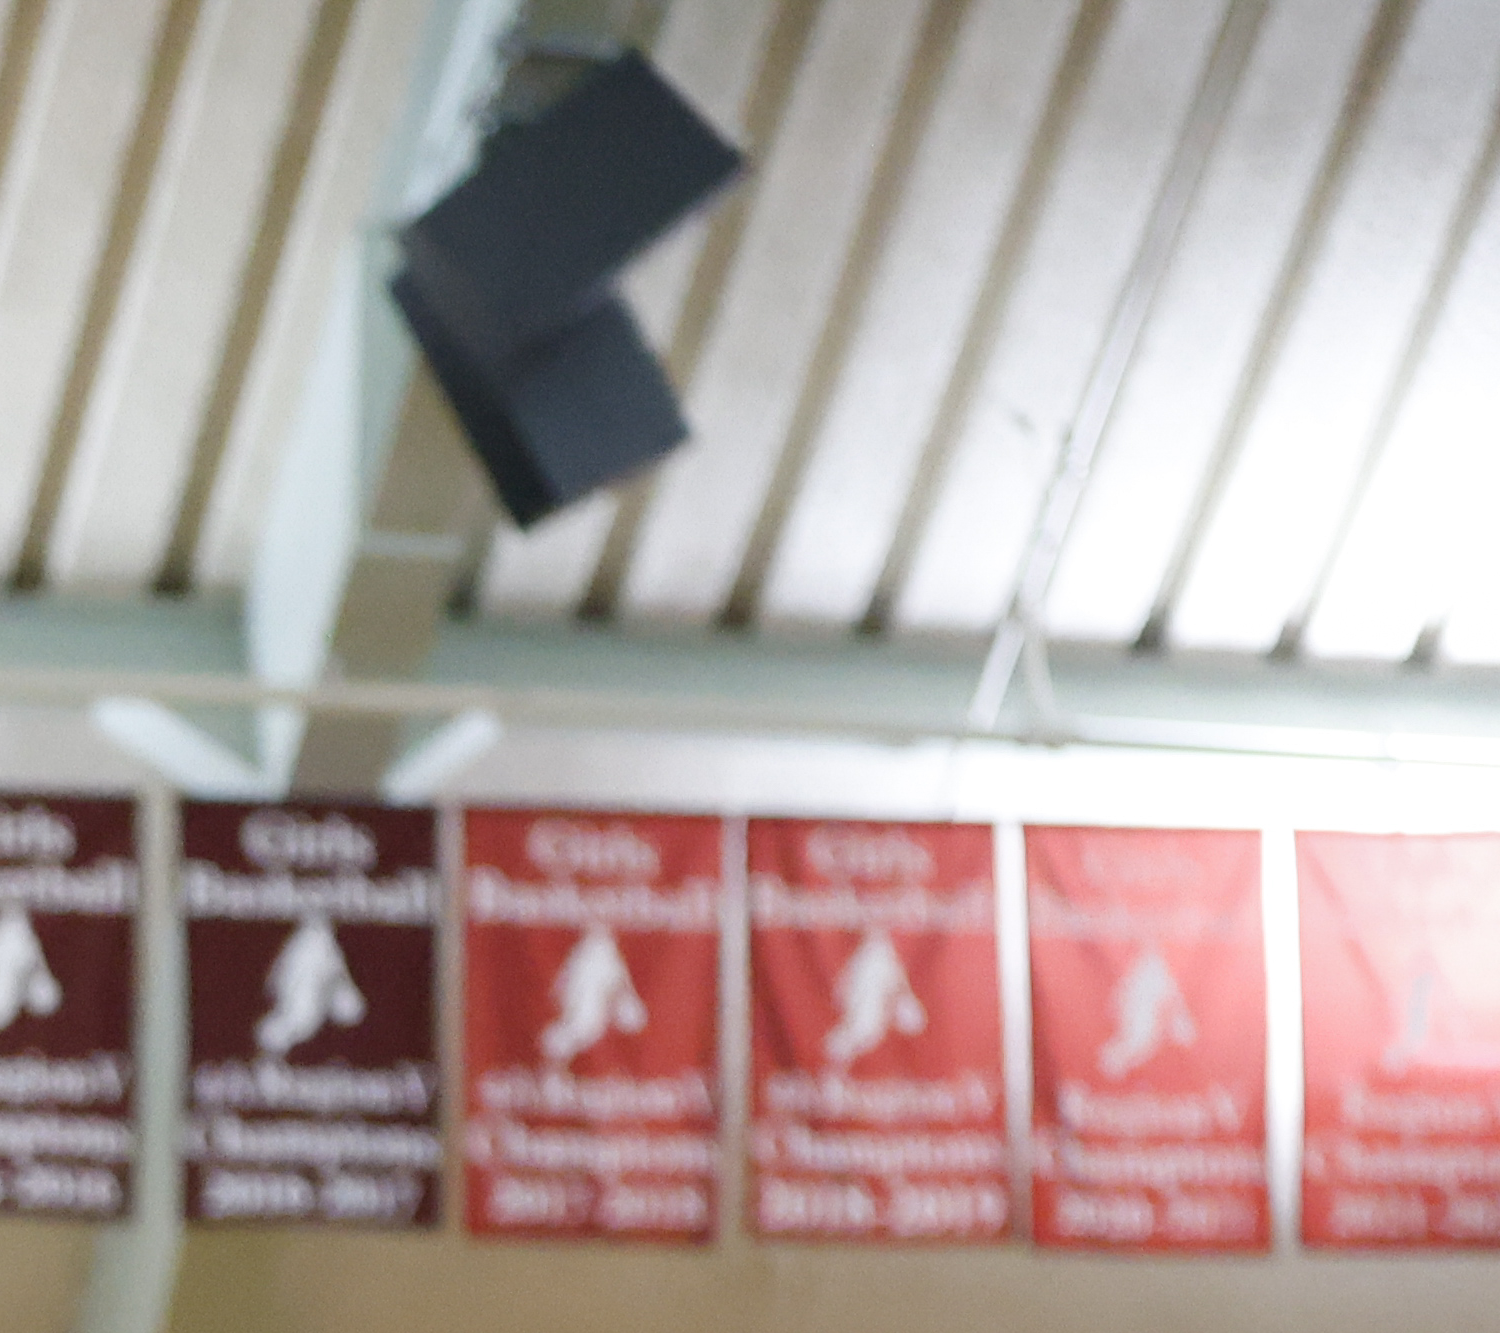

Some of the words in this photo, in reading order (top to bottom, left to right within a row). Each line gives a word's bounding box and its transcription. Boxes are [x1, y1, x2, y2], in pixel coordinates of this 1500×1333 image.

[240, 808, 377, 870] Girls
[527, 817, 660, 883] Girls
[184, 858, 432, 924] Basketball
[466, 866, 718, 931] Basketball
[751, 873, 996, 934] Basketball
